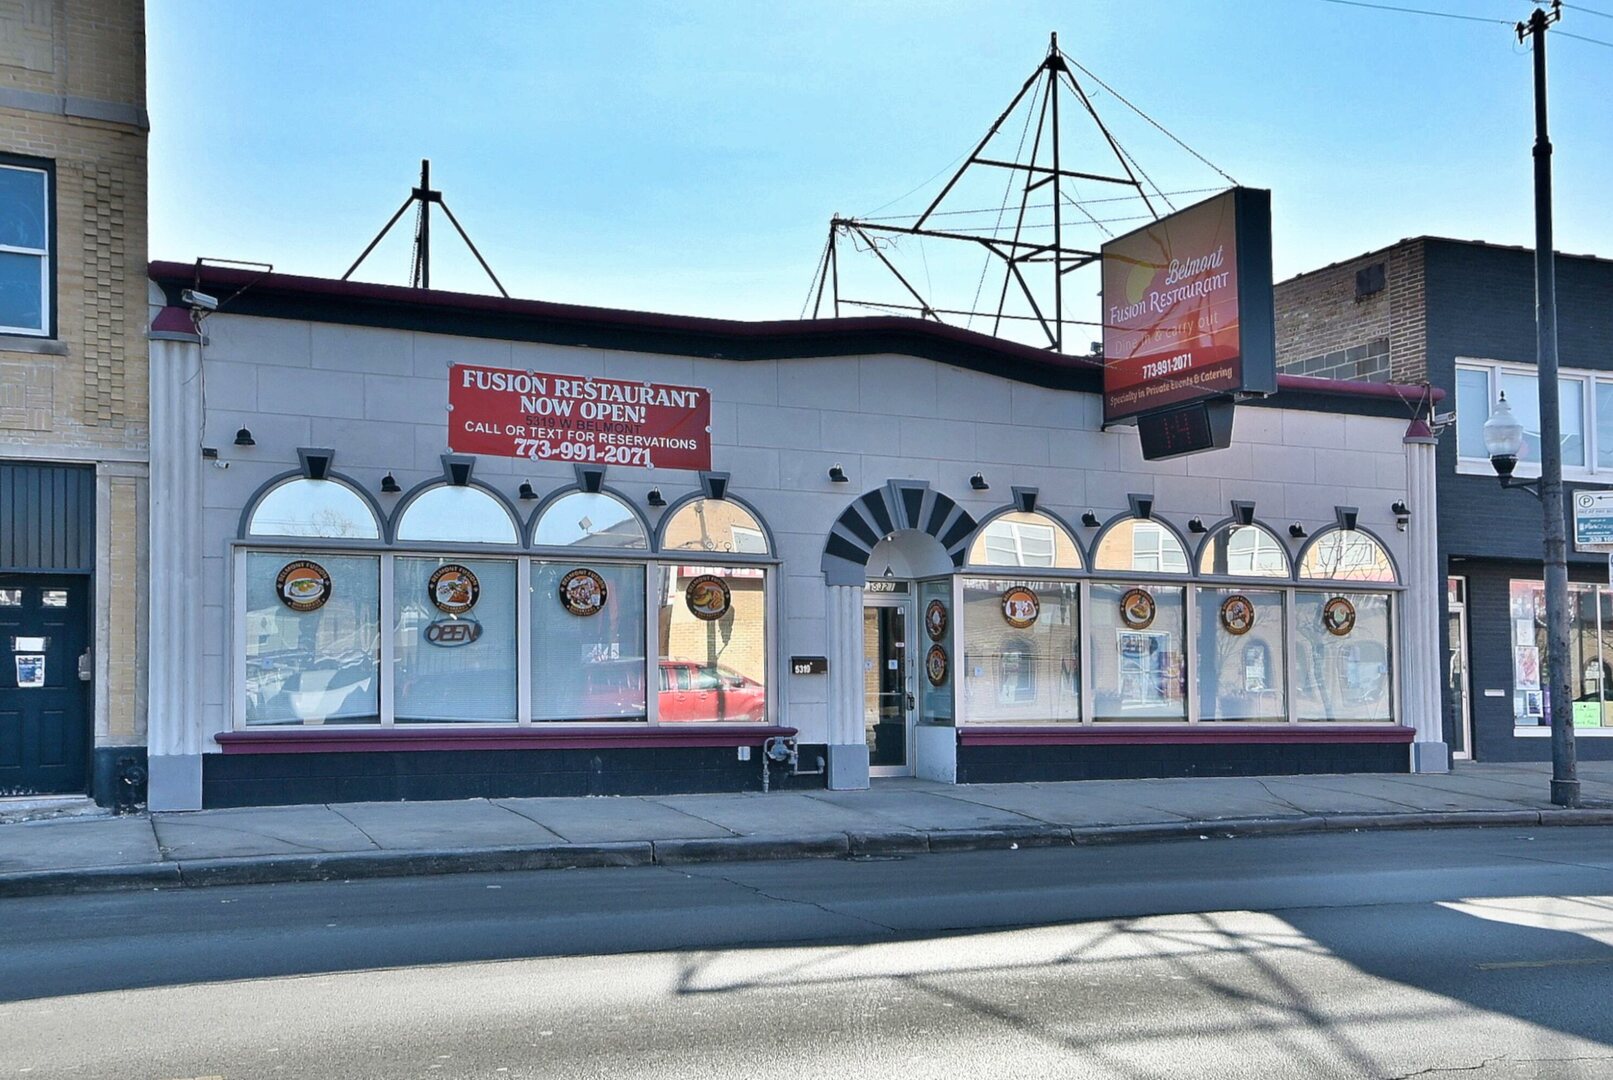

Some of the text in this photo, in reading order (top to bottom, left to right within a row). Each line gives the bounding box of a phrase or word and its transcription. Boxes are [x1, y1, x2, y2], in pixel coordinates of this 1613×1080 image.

[1165, 245, 1224, 285] Belmont
[1115, 340, 1137, 355] Dine
[1165, 321, 1194, 338] carry
[1198, 311, 1219, 328] out
[1142, 353, 1192, 379] 773-991-2071
[462, 369, 699, 409] FUSION RESTAURANT
[1146, 382, 1170, 396] Private
[1170, 376, 1193, 390] Events
[1193, 374, 1200, 384] &
[1200, 366, 1233, 383] Catering
[520, 395, 646, 424] NOW OPEN!
[464, 420, 698, 450] CALL OR TEXT FOR RESERVATIONS
[525, 415, 642, 435] 5319 W BELMONT
[514, 438, 651, 466] 773-991-2071
[428, 623, 480, 642] OPEN
